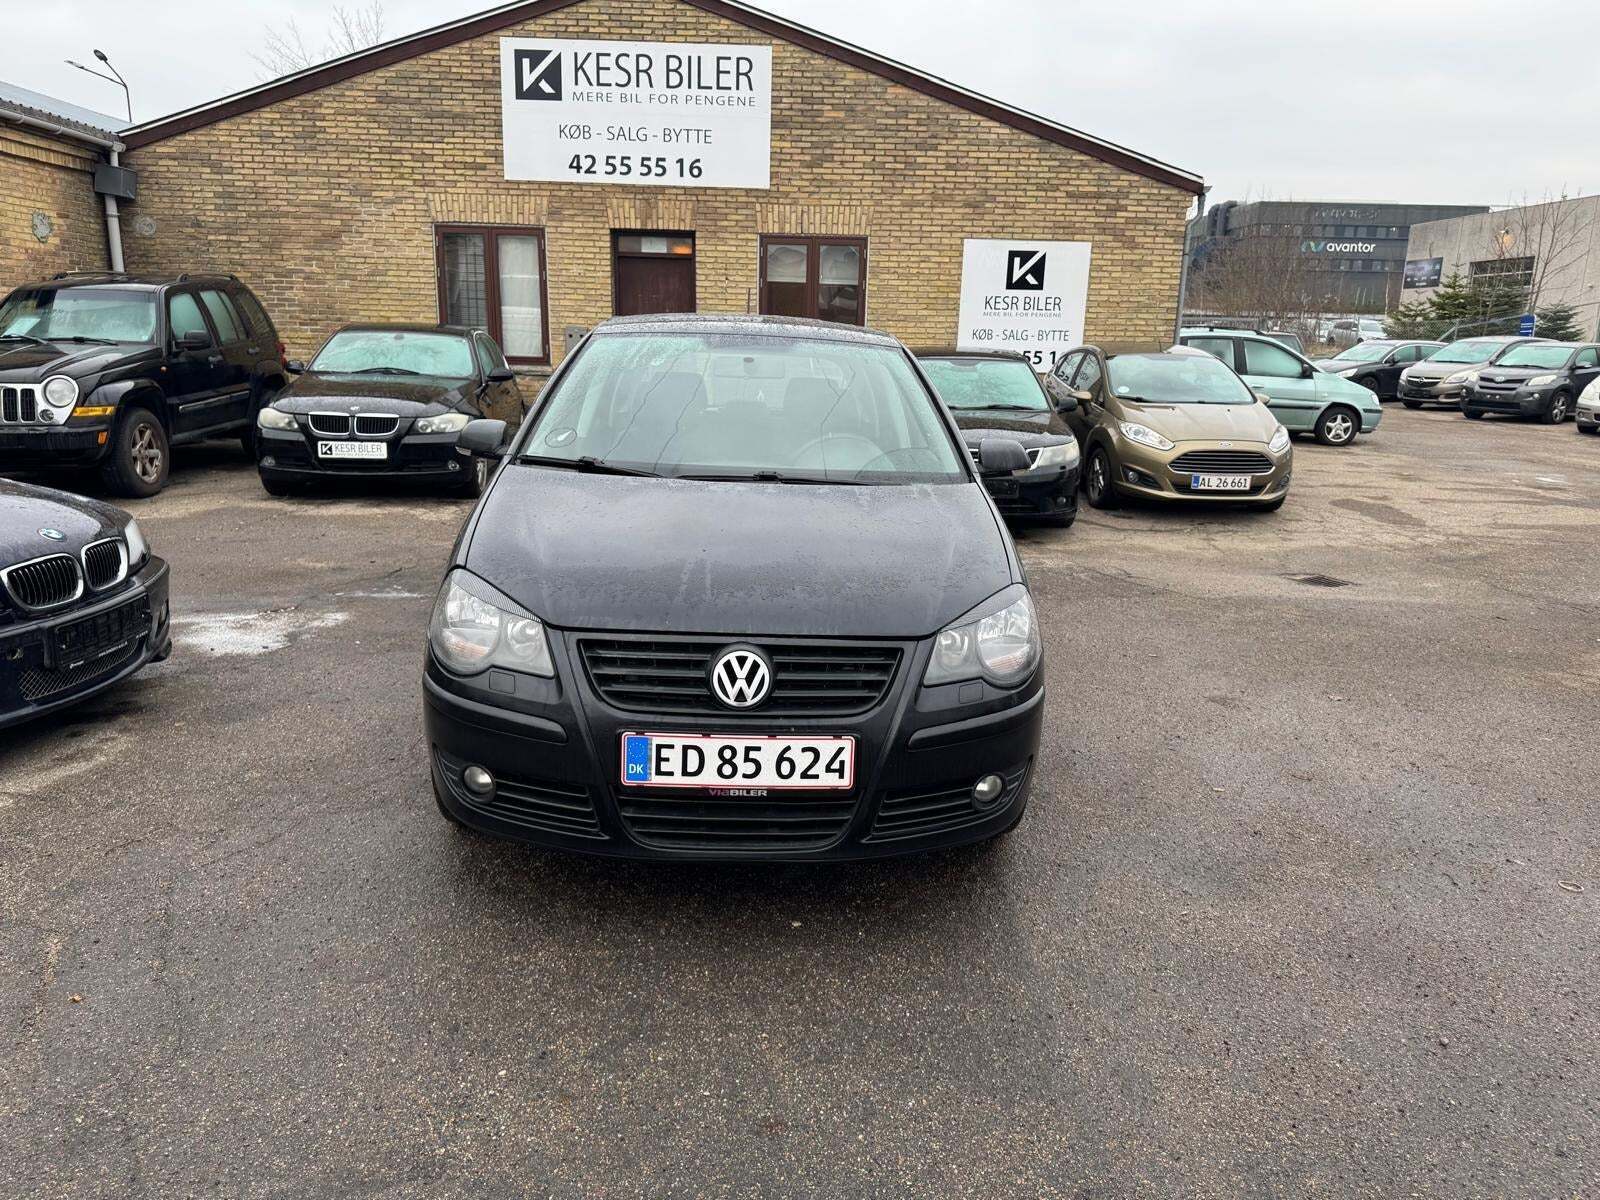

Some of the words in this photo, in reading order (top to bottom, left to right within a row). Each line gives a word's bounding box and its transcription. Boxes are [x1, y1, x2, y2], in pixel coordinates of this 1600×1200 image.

[573, 52, 653, 88] KESR
[665, 55, 753, 91] BILER
[572, 91, 613, 103] MERE
[620, 92, 643, 104] BIL
[649, 94, 679, 105] FOR
[685, 95, 756, 107] PENGENE
[558, 125, 592, 140] KØB
[606, 126, 648, 142] SALG
[663, 128, 713, 144] BYTTE
[568, 154, 597, 175] 42
[604, 155, 632, 176] 55
[639, 157, 667, 177] 55
[675, 158, 703, 178] 16
[1326, 241, 1376, 253] avantor
[984, 295, 1019, 311] KESR
[1023, 296, 1062, 312] BILER
[972, 328, 994, 341] KØB
[1001, 329, 1029, 341] SALG
[1037, 330, 1070, 342] BYTTE
[334, 443, 356, 452] KESR
[358, 443, 382, 452] BILER
[1200, 478, 1213, 488] AL
[1216, 478, 1229, 488] 26
[628, 763, 644, 774] DK
[655, 743, 706, 777] ED
[716, 745, 762, 780] 85
[775, 745, 846, 780] 624
